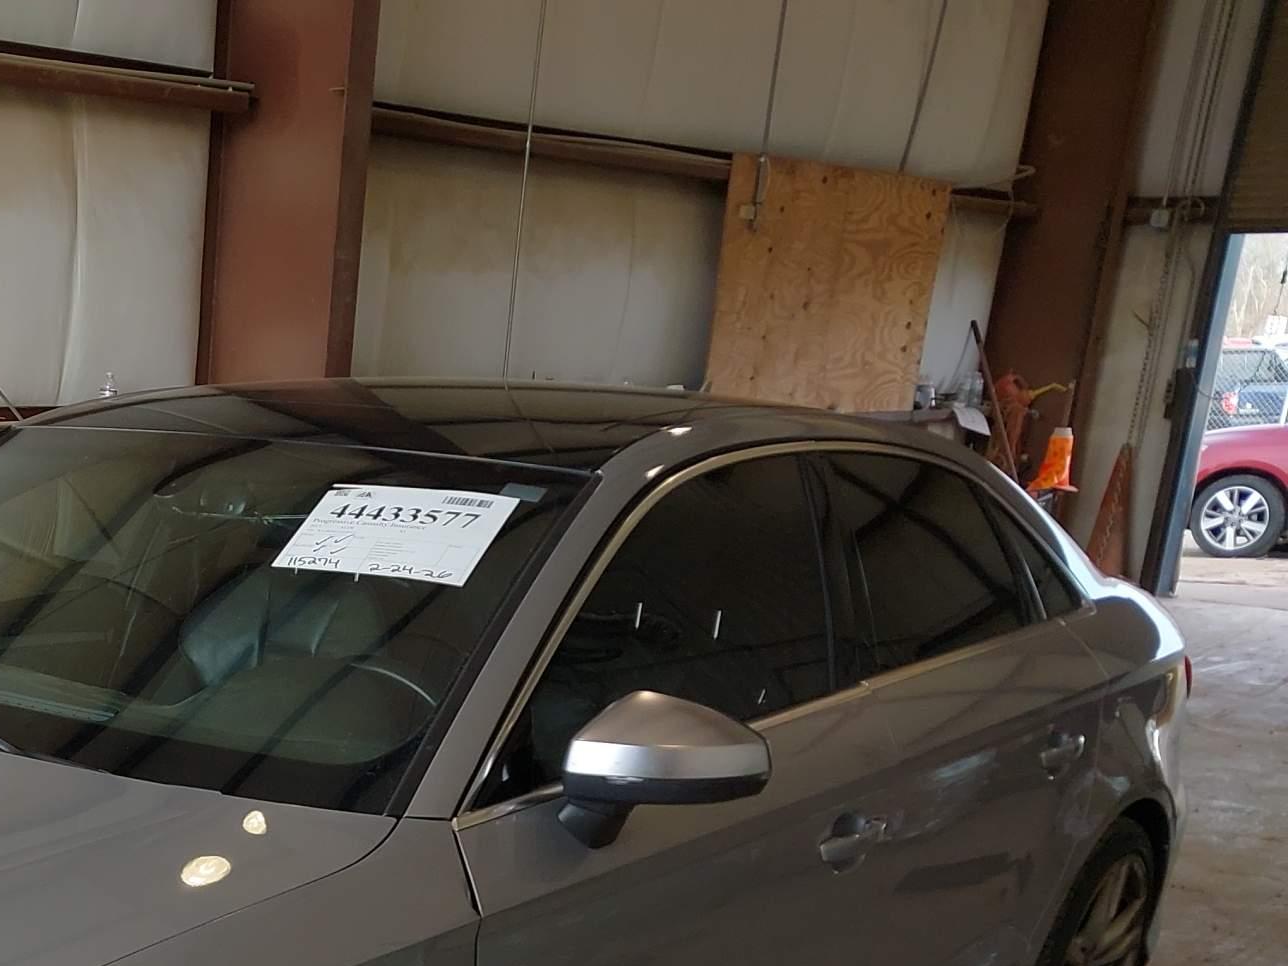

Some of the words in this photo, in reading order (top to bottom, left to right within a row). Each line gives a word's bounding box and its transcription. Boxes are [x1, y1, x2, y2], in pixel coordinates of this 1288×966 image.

[329, 502, 482, 529] 44433577
[287, 556, 341, 569] 115274
[368, 563, 453, 579] 2-24-26
